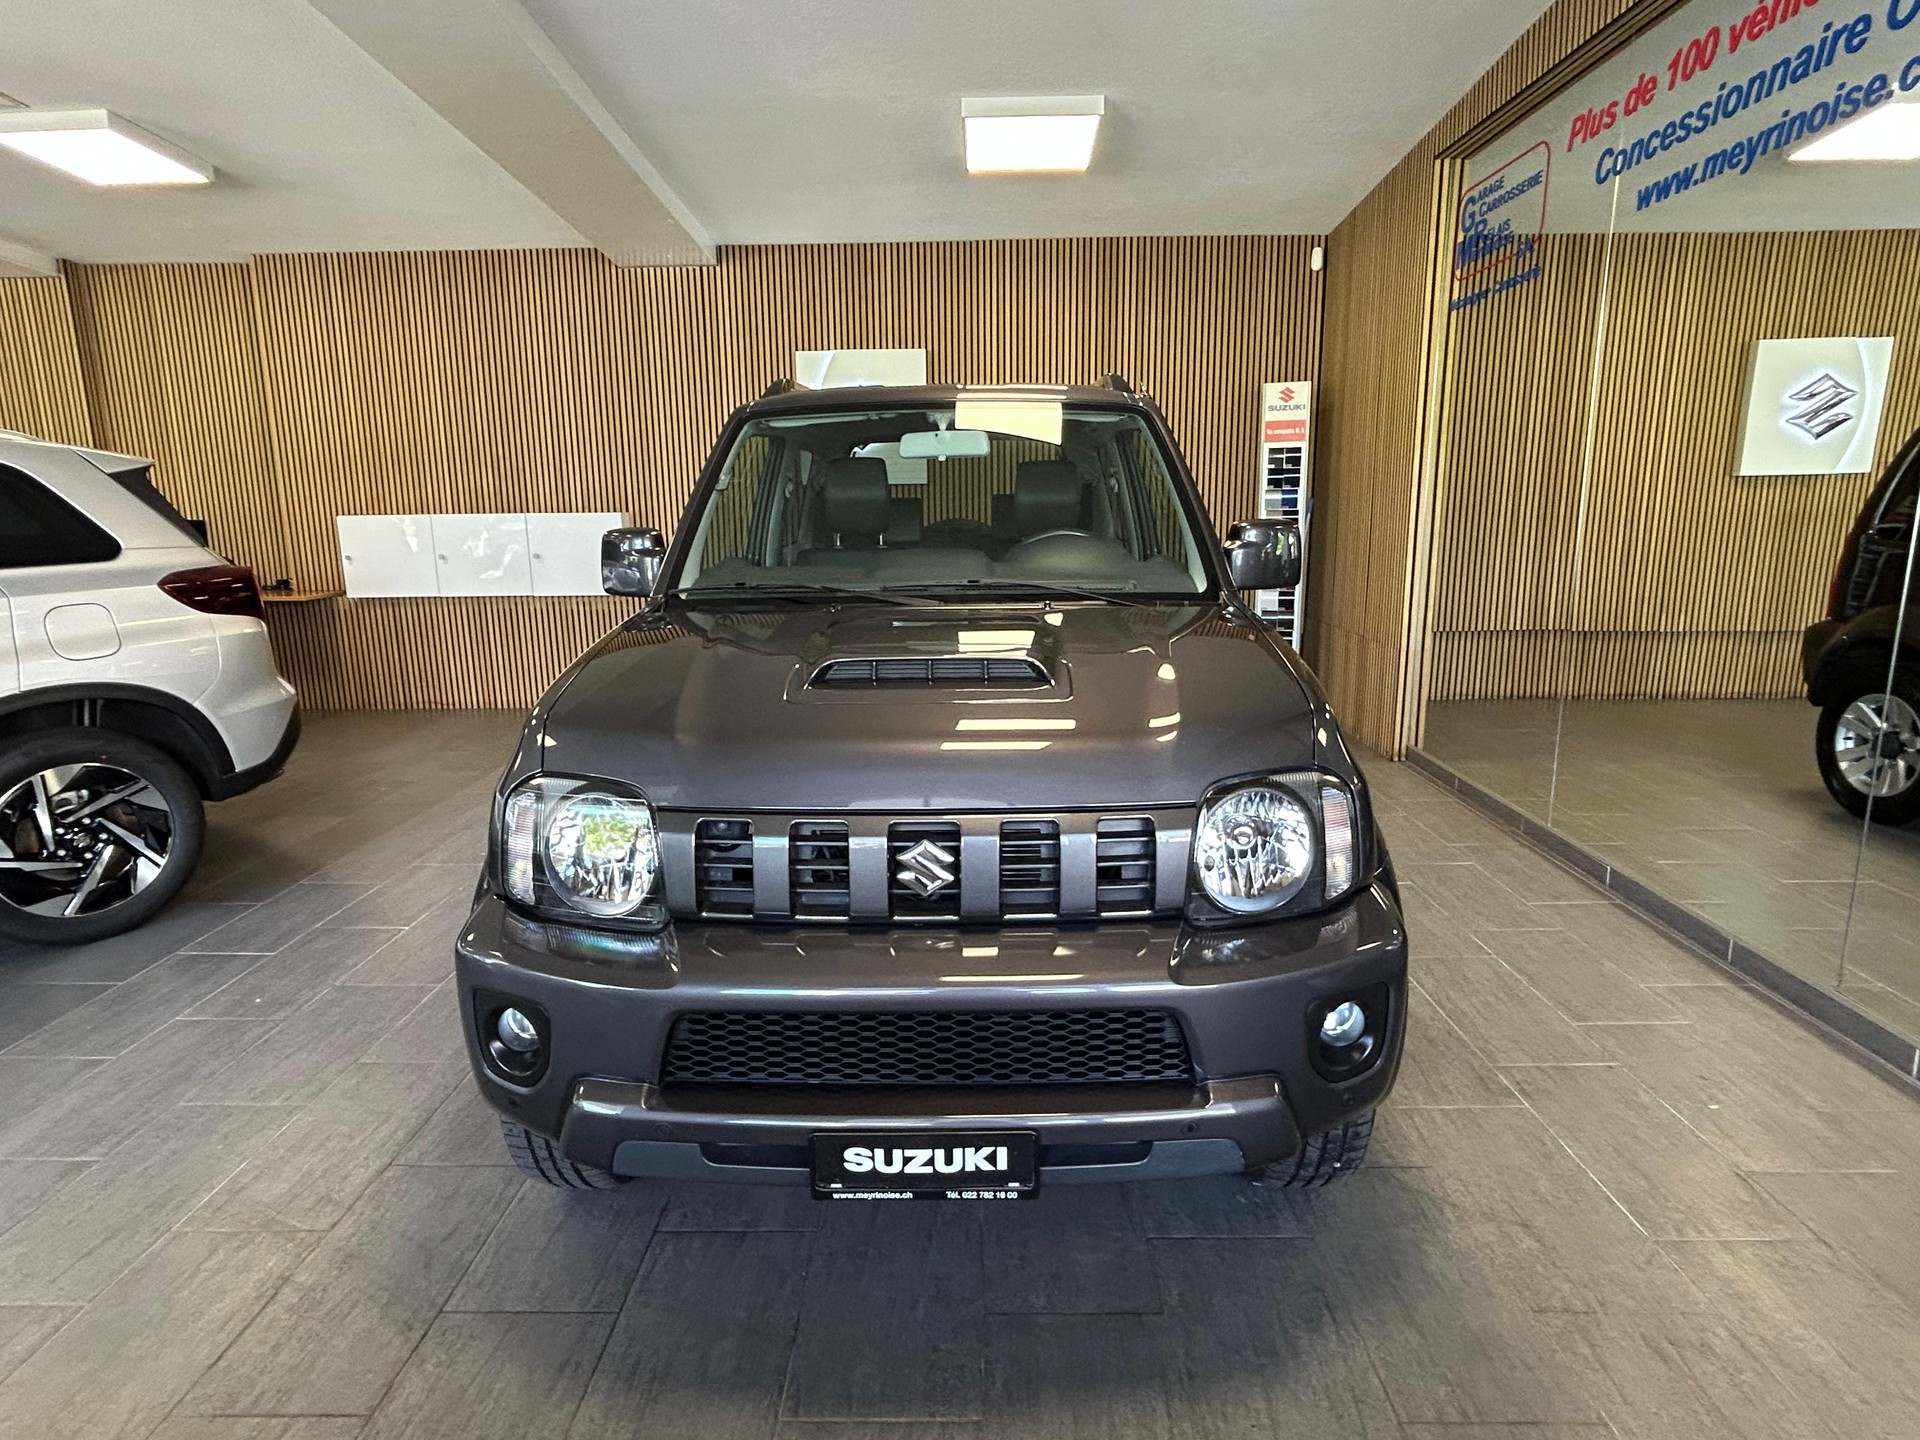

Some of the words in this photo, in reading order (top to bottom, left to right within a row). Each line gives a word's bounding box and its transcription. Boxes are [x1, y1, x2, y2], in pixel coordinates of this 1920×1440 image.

[1567, 100, 1619, 152] Plus
[1623, 73, 1658, 117] de
[1667, 26, 1720, 91] 100
[1595, 13, 1873, 185] Concessionnaire
[1479, 169, 1543, 217] CARROSSERIE
[1267, 404, 1306, 412] SUZUKI
[843, 1147, 1008, 1173] SUZUKI
[832, 1191, 913, 1200] www.meyrinoise.ch
[962, 1191, 978, 1199] 022
[1006, 1191, 1018, 1199] 00
